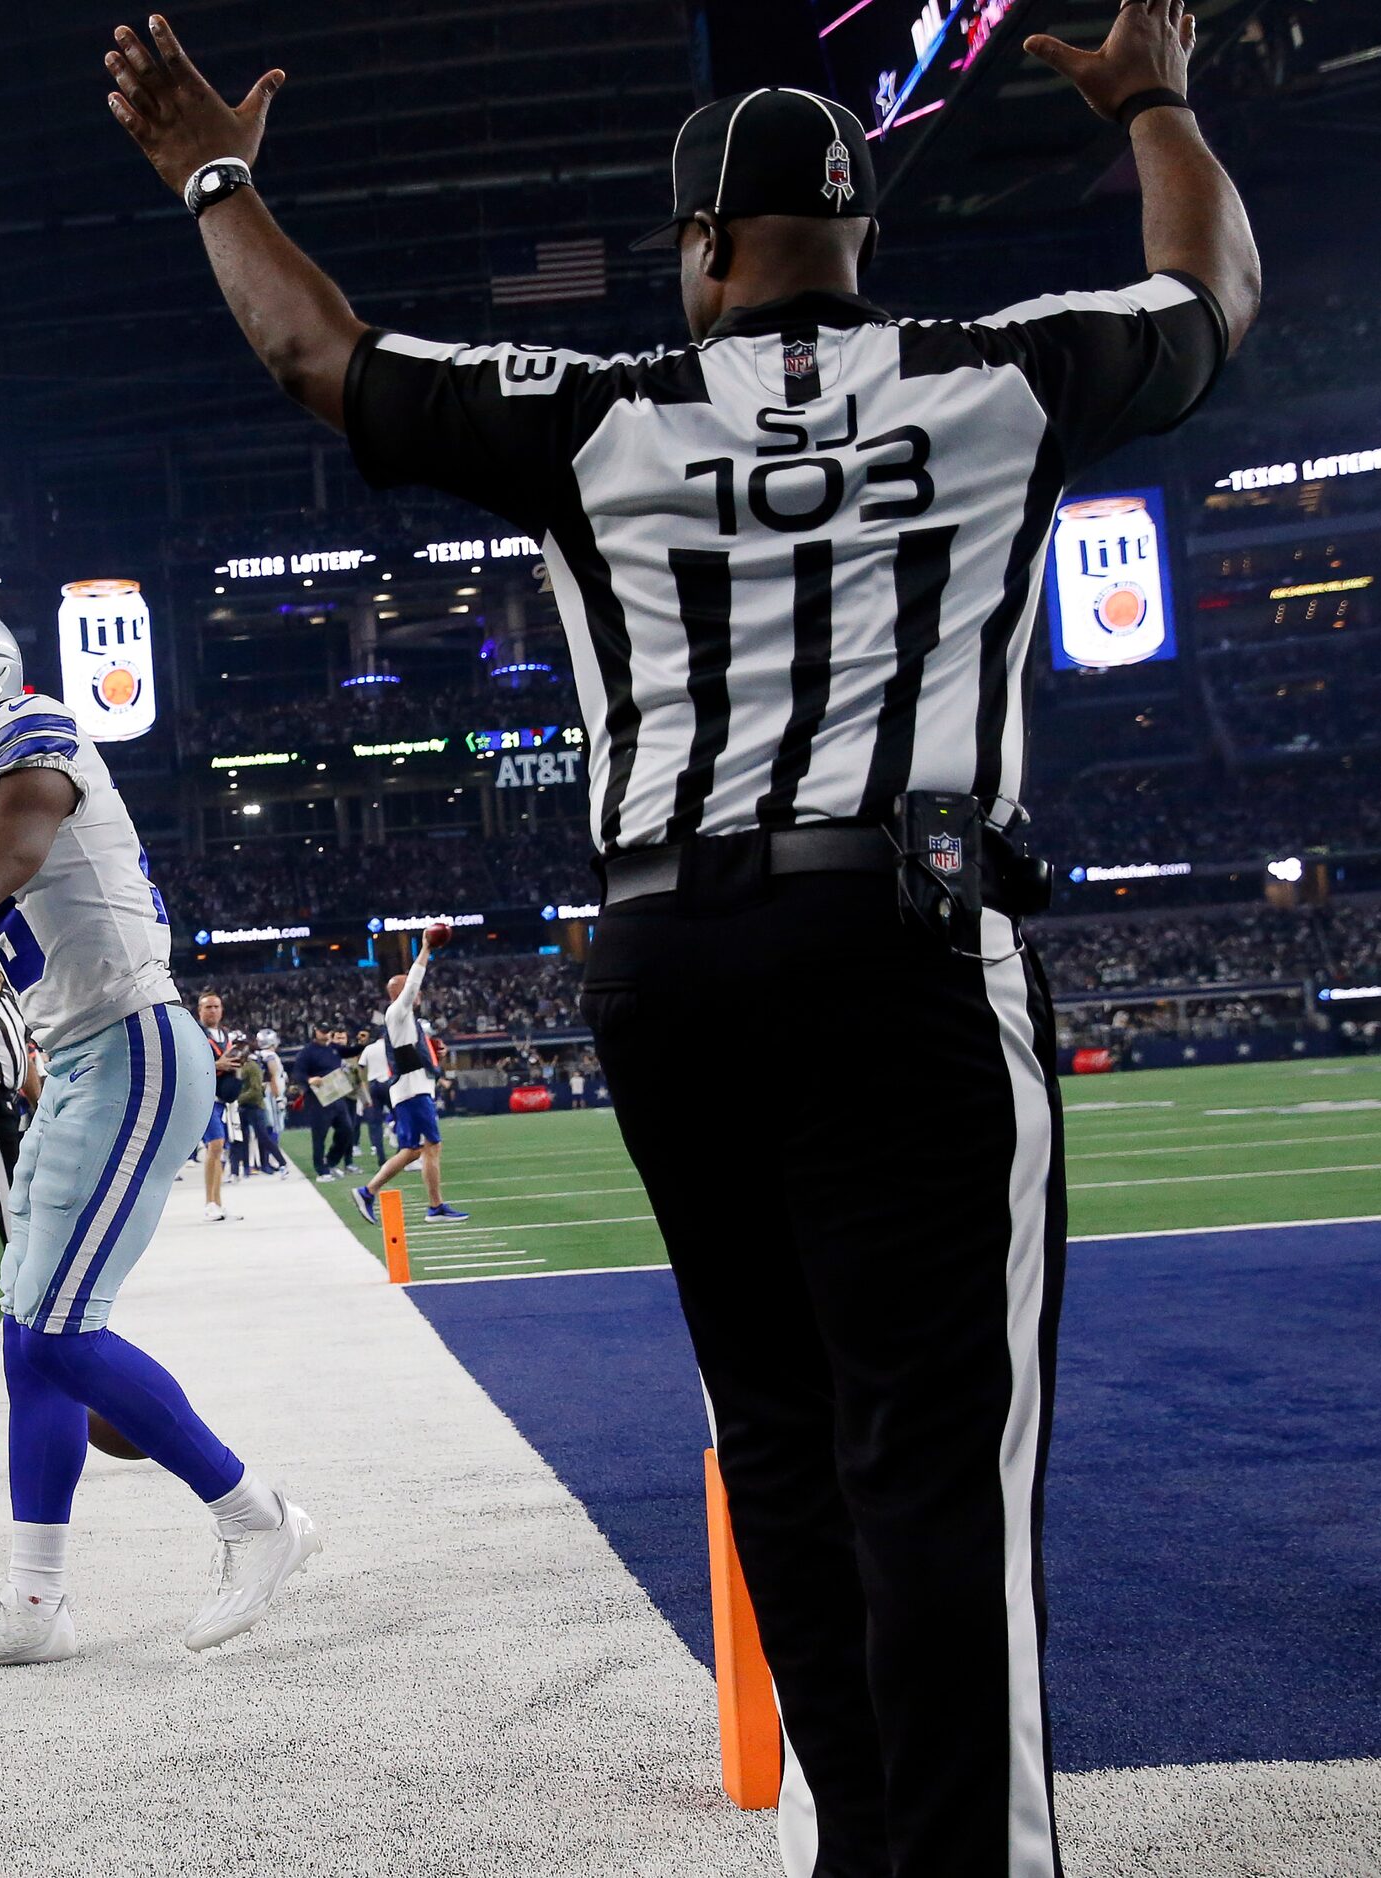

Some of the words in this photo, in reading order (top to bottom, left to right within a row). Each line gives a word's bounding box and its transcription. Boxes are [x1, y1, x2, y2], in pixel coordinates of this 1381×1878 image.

[786, 356, 813, 374] NFL
[756, 394, 858, 457] SJ
[685, 425, 935, 535] 103
[1079, 535, 1149, 578] Lite
[79, 616, 145, 656] Lite
[501, 731, 520, 748] 21
[495, 750, 581, 788] AT&T
[934, 851, 958, 870] NFL
[1086, 862, 1191, 881] Blockchain.com
[384, 913, 484, 932] Blockchain.com
[211, 926, 310, 944] Blockchain.com
